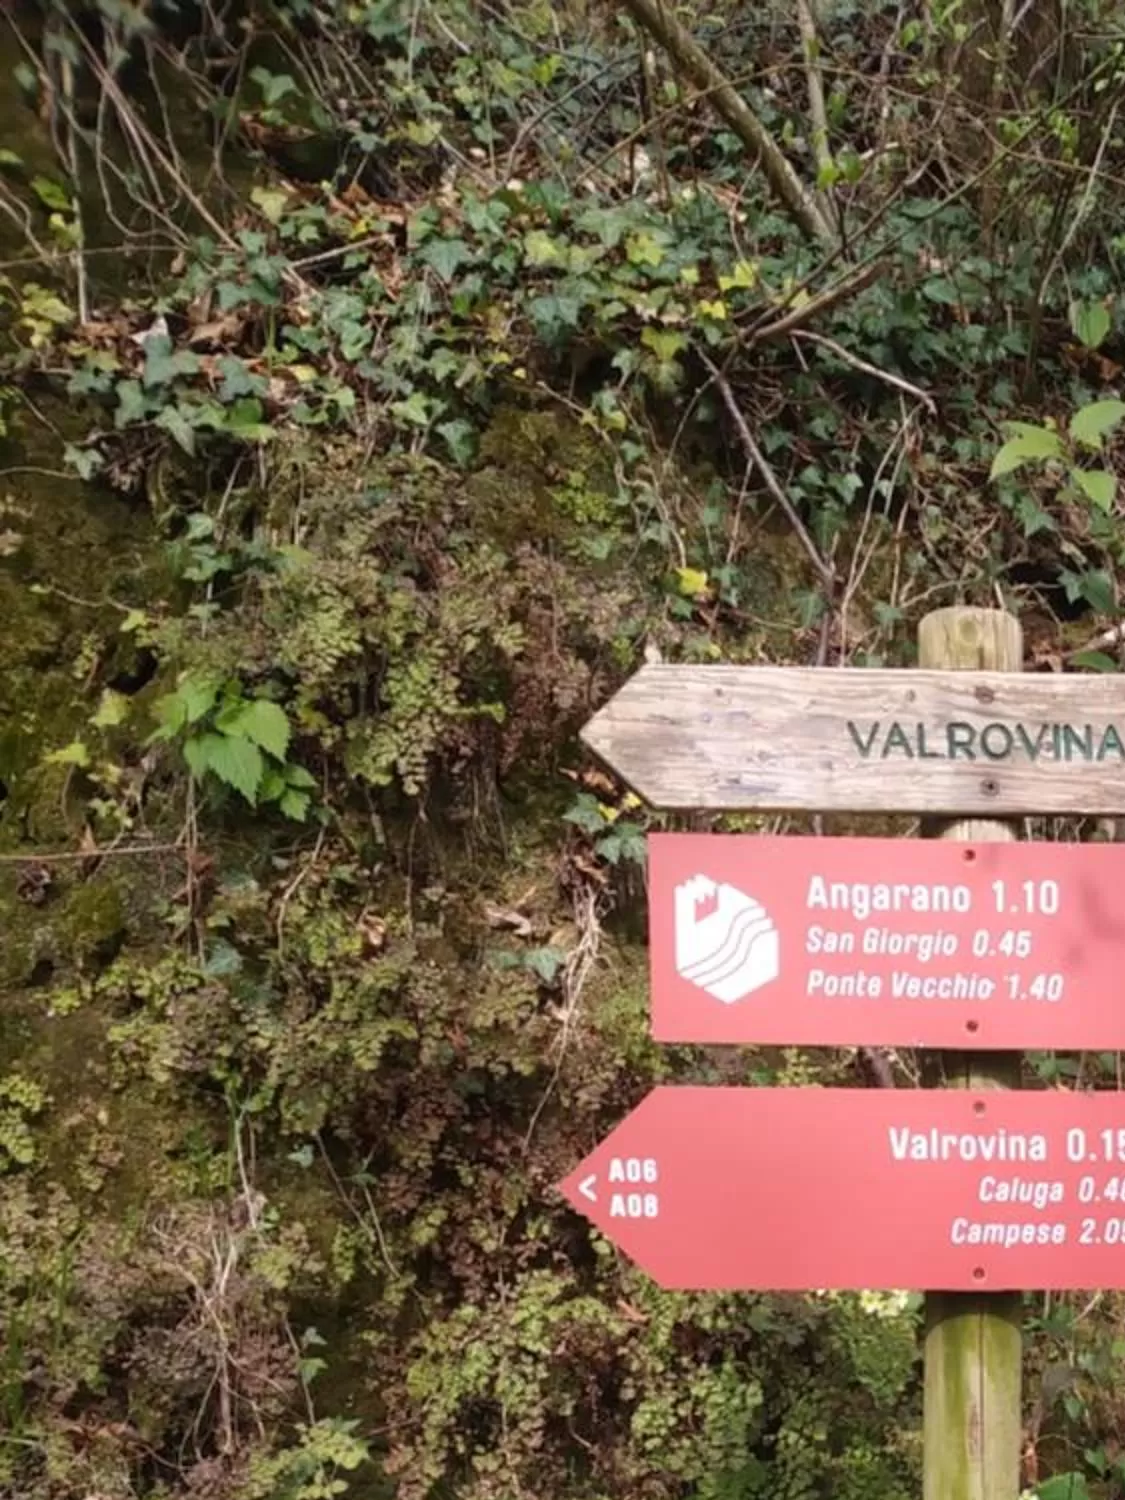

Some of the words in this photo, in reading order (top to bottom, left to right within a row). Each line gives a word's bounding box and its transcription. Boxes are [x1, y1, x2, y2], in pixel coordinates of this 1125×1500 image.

[805, 874, 972, 921] Angarano
[990, 878, 1060, 915] 1.10
[804, 925, 855, 955] San
[861, 926, 959, 961] Giorgio
[971, 927, 1034, 960] 0.45
[805, 968, 883, 998] Ponte
[890, 970, 996, 1001] Vecchio
[1002, 973, 1065, 1002] 1.40
[888, 1126, 1048, 1163] Valrovina
[608, 1157, 658, 1184] A06
[978, 1175, 1065, 1210] Caluga
[950, 1217, 1067, 1248] Campese
